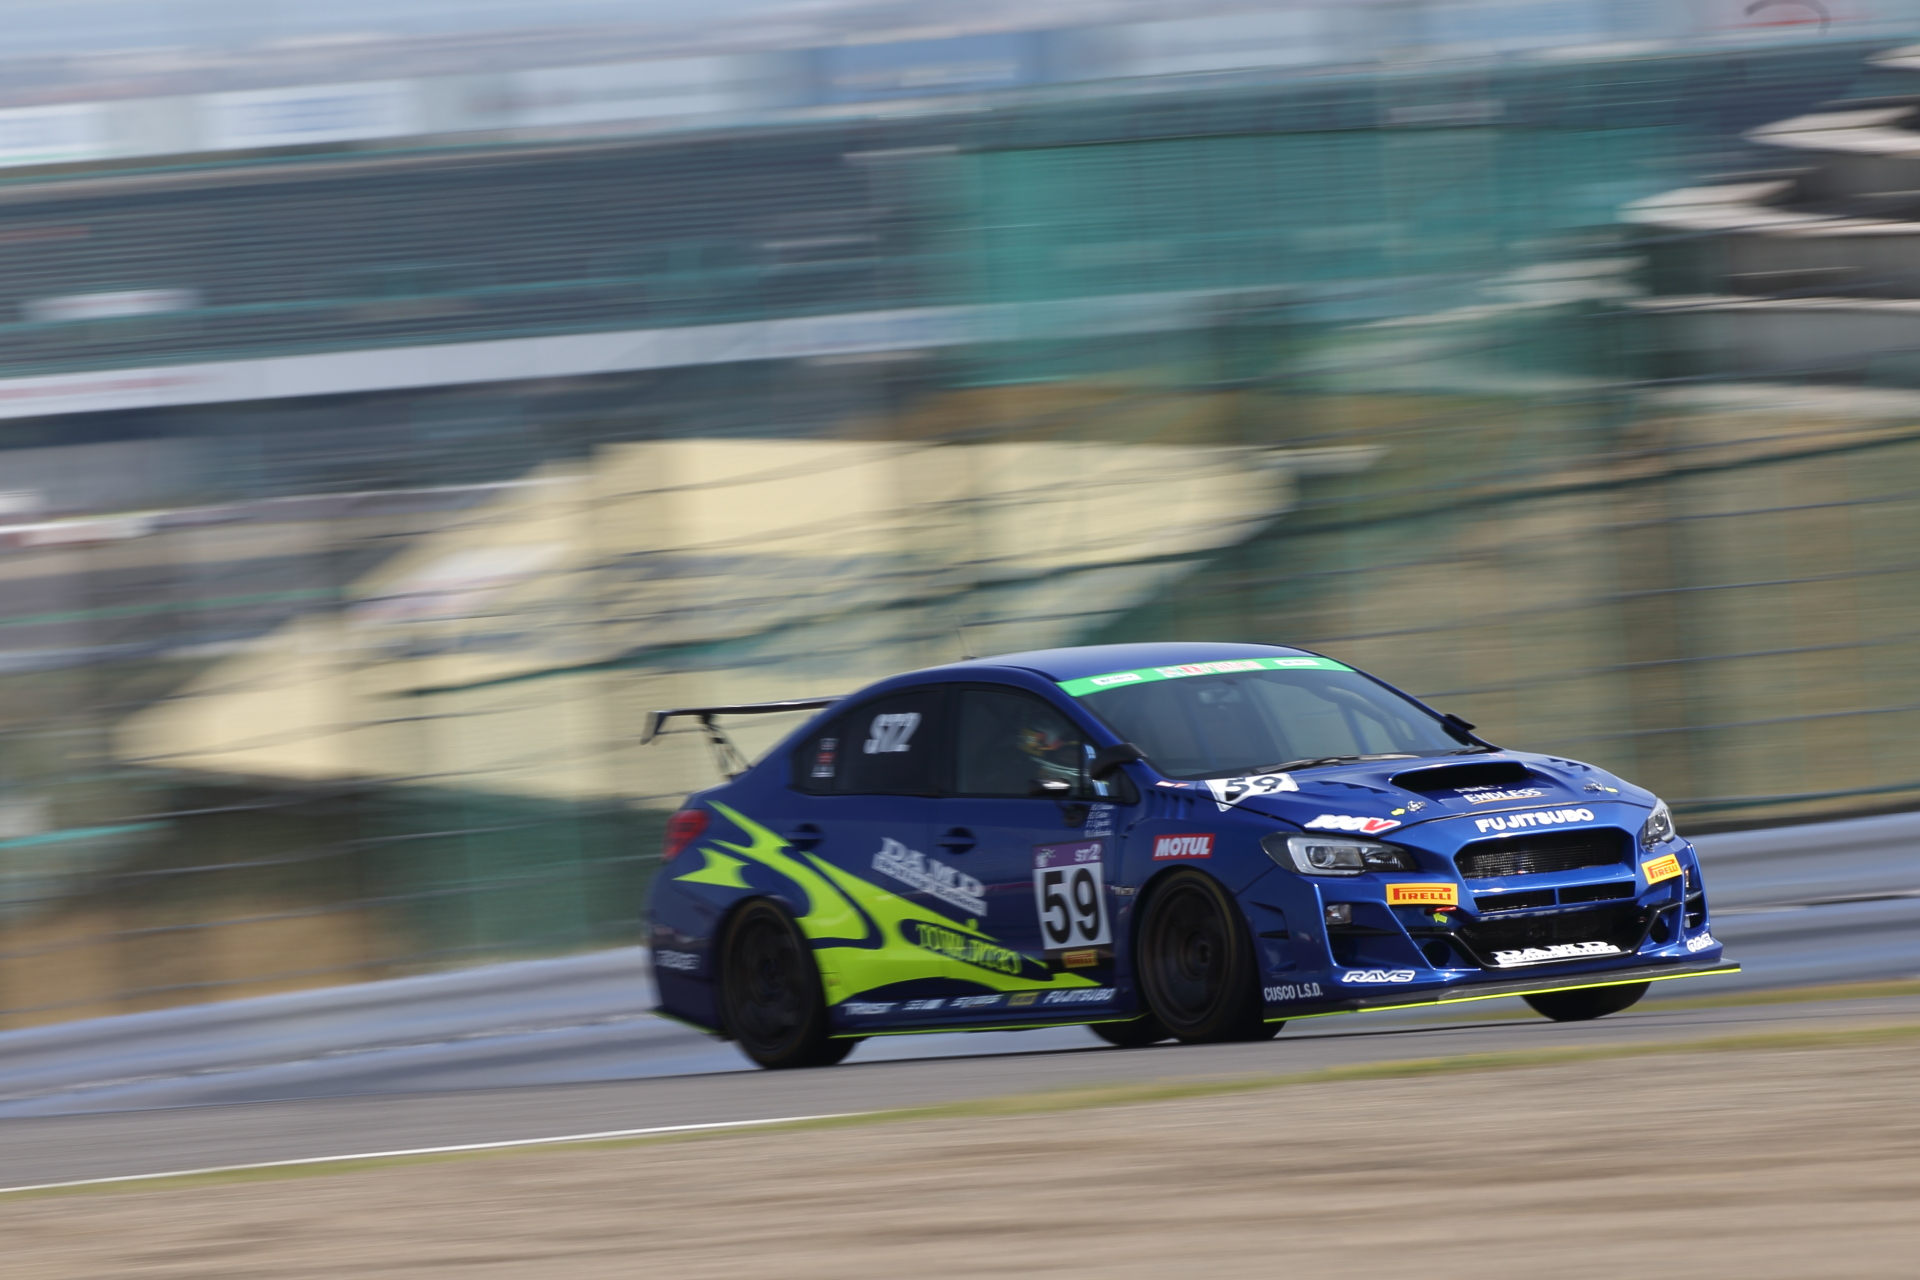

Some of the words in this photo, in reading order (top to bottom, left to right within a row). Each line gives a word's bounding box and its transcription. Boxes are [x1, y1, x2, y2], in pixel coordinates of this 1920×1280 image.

[1224, 775, 1283, 802] 59
[1463, 787, 1543, 804] ENDLESS
[1475, 808, 1595, 833] FUJITSUBO
[1154, 836, 1211, 858] MOTUL
[1648, 857, 1679, 881] PIRELLI
[1393, 887, 1452, 901] PIRELLI
[1042, 867, 1101, 945] 59
[1264, 984, 1296, 1002] CUSCO
[1298, 982, 1323, 999] L.S.D.
